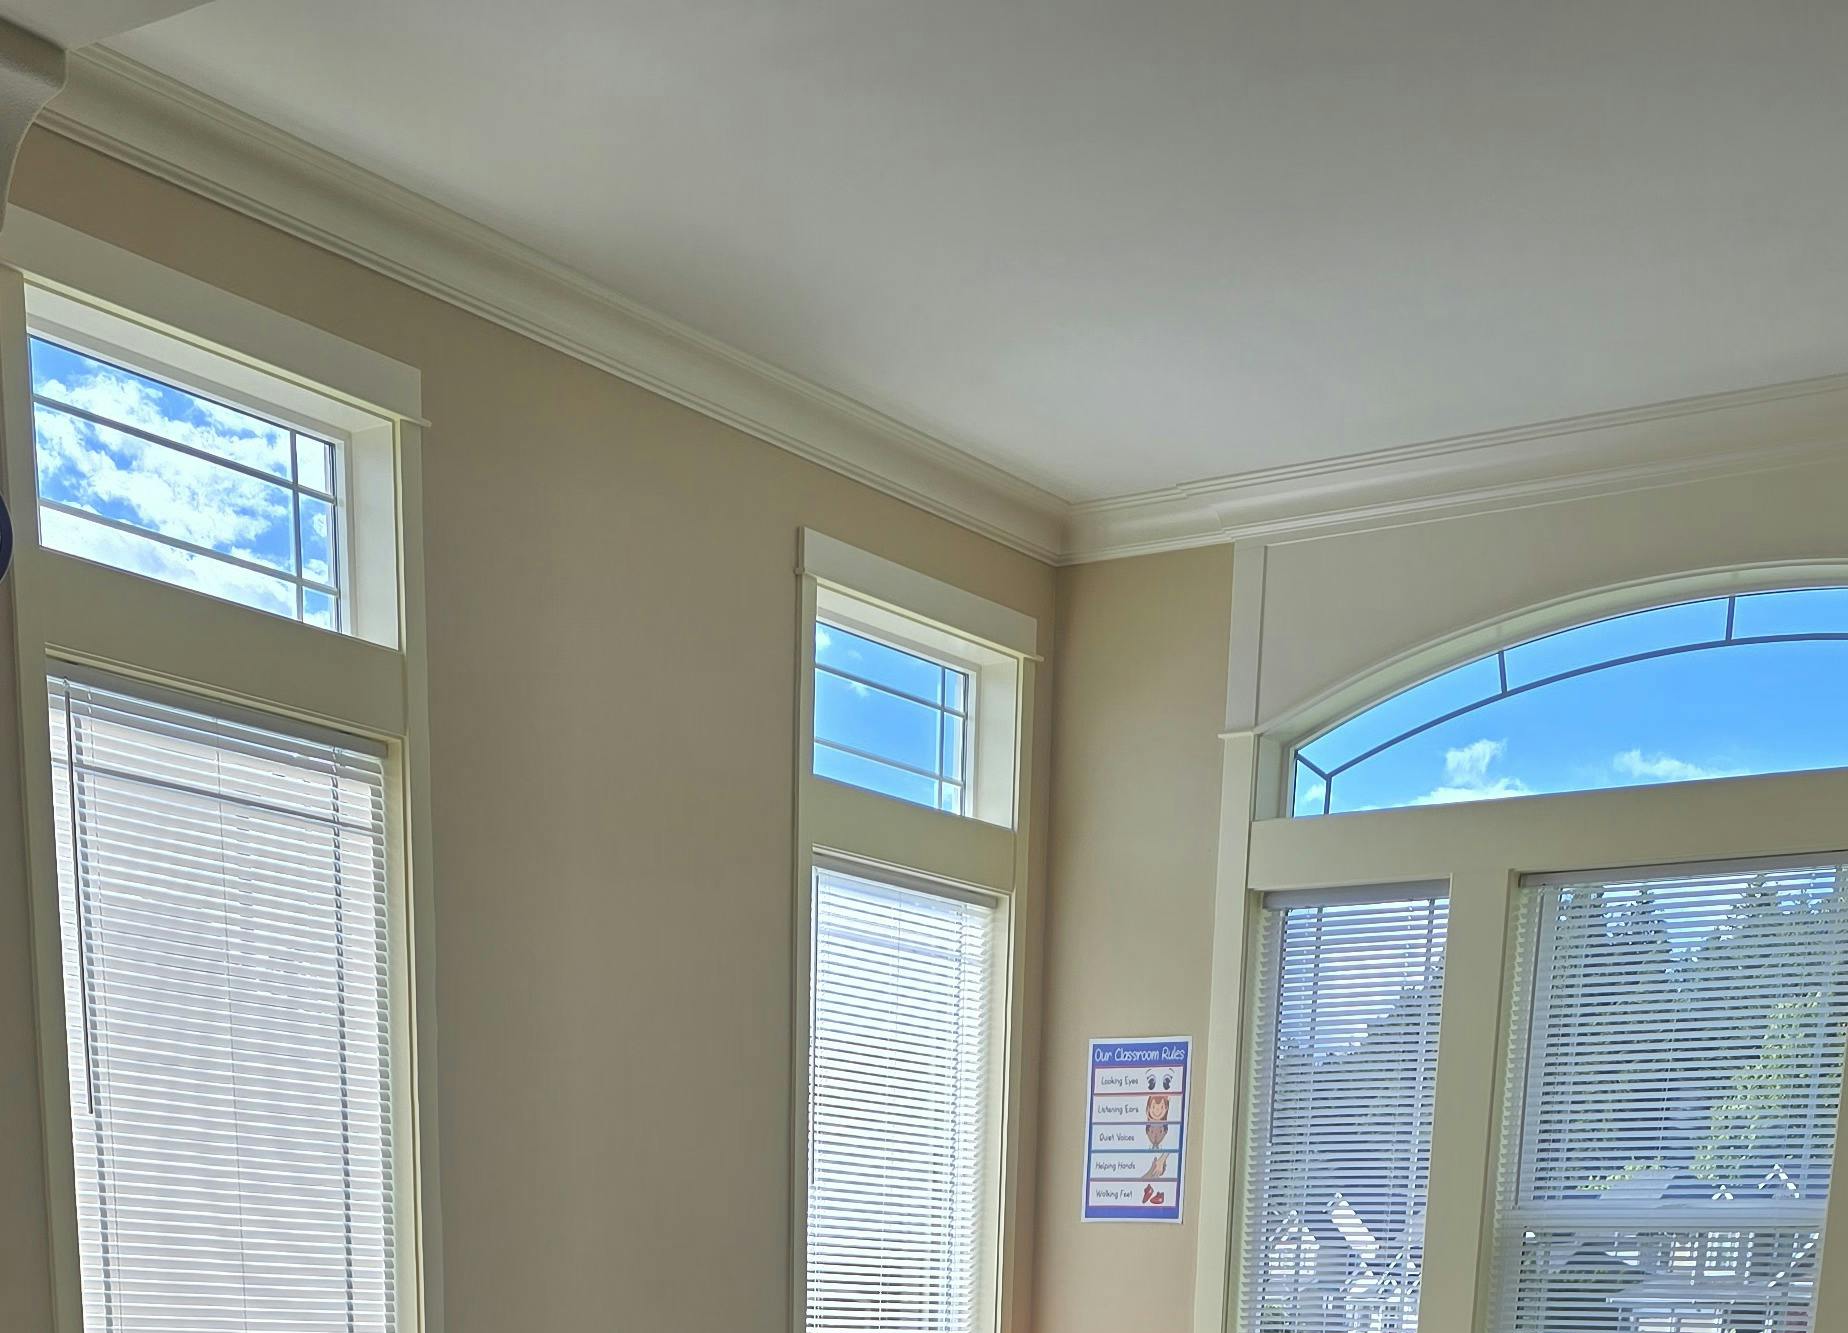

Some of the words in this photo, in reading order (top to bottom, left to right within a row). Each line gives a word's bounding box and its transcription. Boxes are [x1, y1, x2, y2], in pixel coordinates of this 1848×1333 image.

[1095, 1047, 1112, 1062] Our
[1114, 1047, 1159, 1062] Classroom
[1161, 1045, 1186, 1060] Rules
[1101, 1076, 1122, 1087] Looking
[1124, 1075, 1139, 1087] Eyes
[1097, 1103, 1123, 1115] Listening
[1125, 1104, 1139, 1113] Ears
[1099, 1132, 1114, 1142] Quiet
[1116, 1132, 1135, 1142] Voices
[1095, 1162, 1117, 1172] Helping
[1117, 1161, 1136, 1170] Hands
[1096, 1189, 1118, 1200] Walking
[1119, 1189, 1133, 1198] Feet
